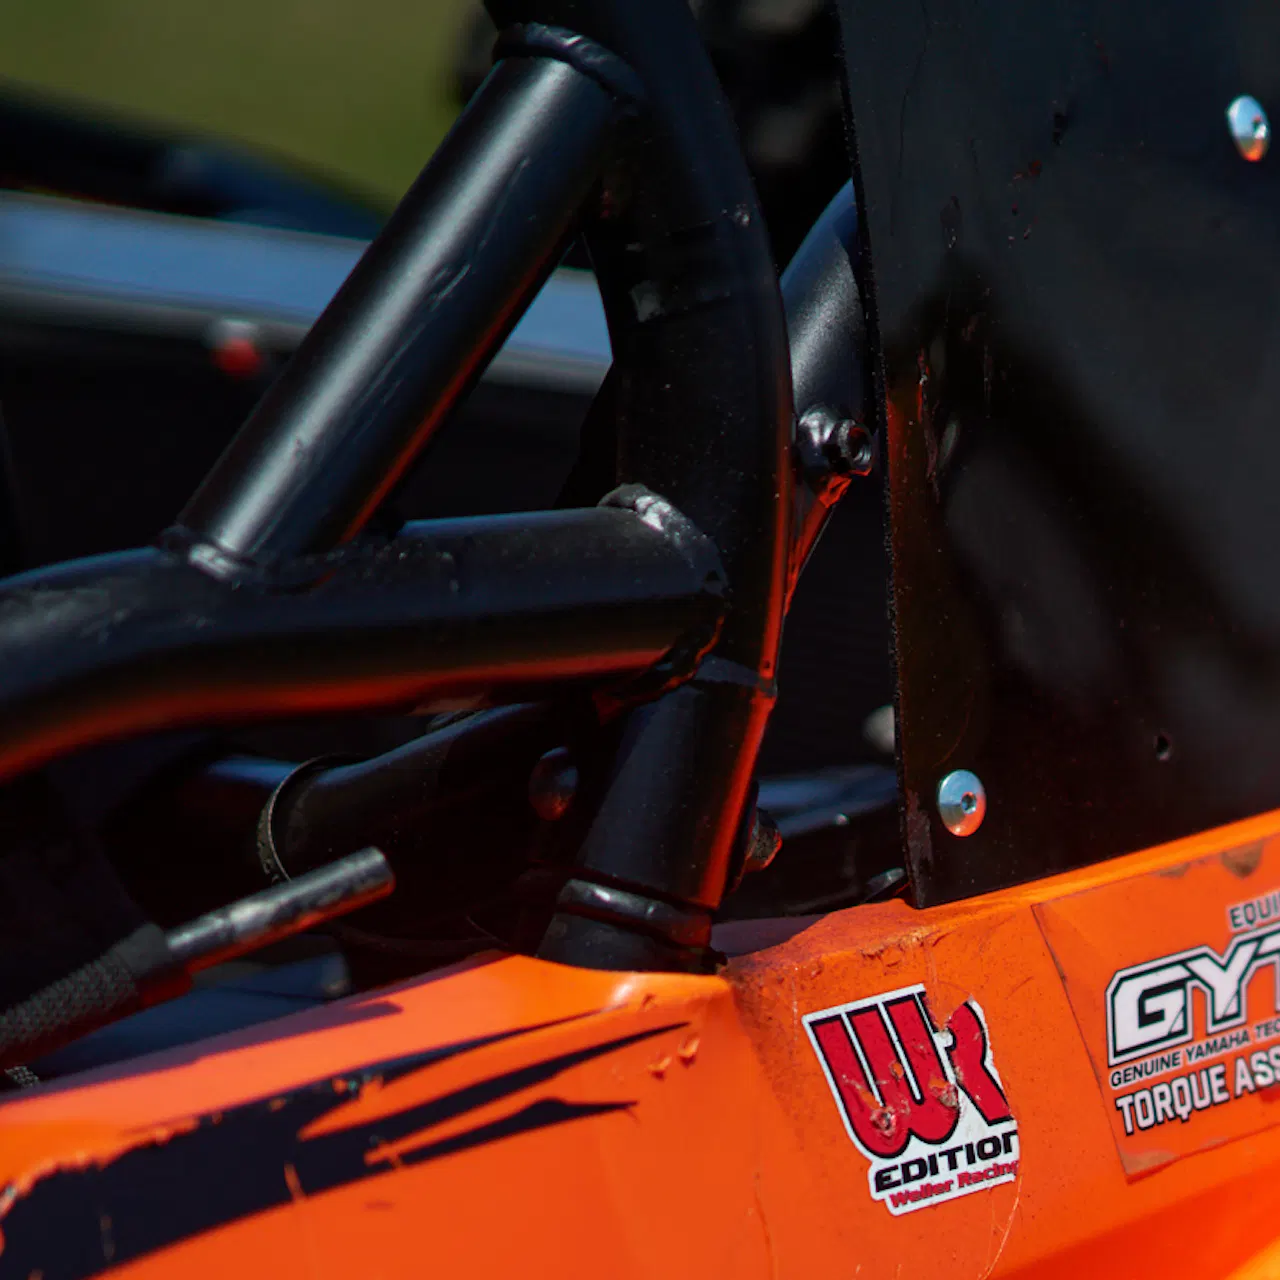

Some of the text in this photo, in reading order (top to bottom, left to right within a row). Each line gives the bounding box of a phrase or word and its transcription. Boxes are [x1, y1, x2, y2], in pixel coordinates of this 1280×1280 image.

[1110, 1050, 1182, 1088] GENUINE
[1185, 1030, 1250, 1062] YAMAHA
[1115, 1063, 1230, 1136] TORQUE
[888, 1179, 955, 1208] Weller
